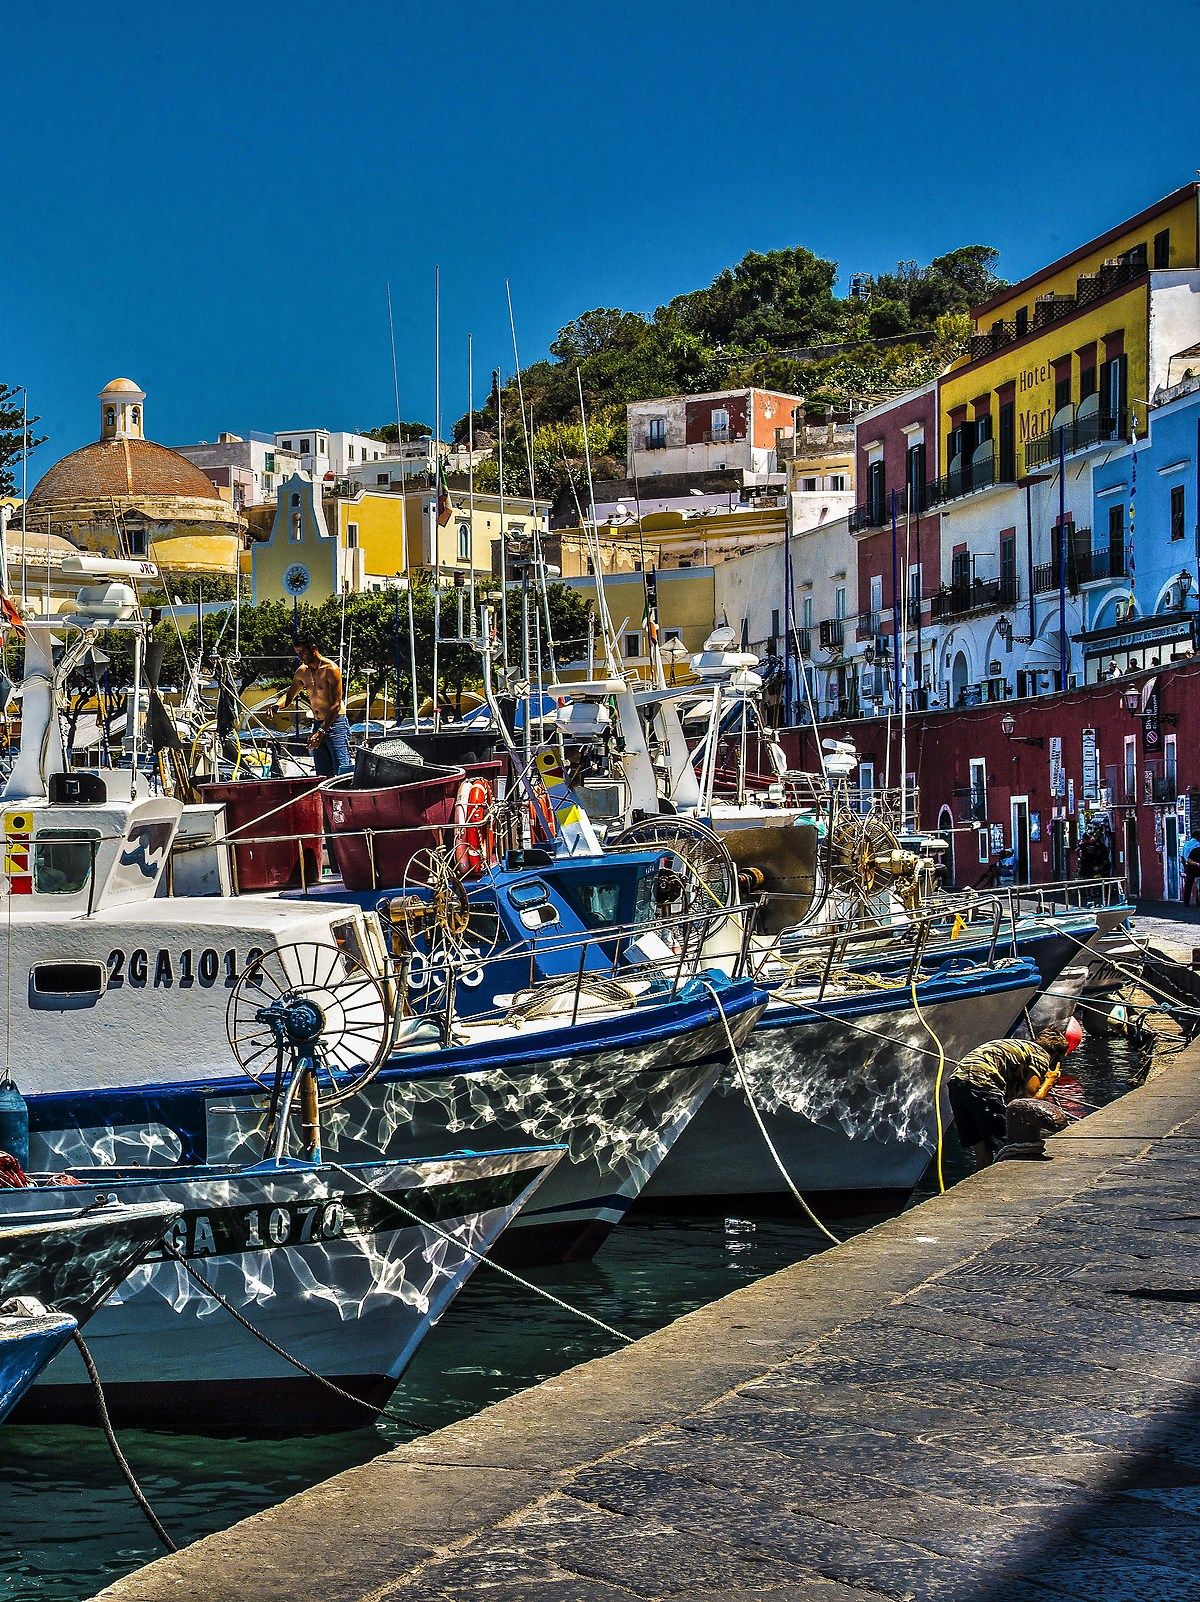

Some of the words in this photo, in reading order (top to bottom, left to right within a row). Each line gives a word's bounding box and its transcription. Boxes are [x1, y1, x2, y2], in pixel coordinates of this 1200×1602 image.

[1019, 358, 1051, 392] Hotel
[1019, 399, 1051, 443] Mari
[139, 563, 155, 575] JRC
[107, 946, 264, 989] 2GA1012
[244, 1201, 344, 1247] 1070
